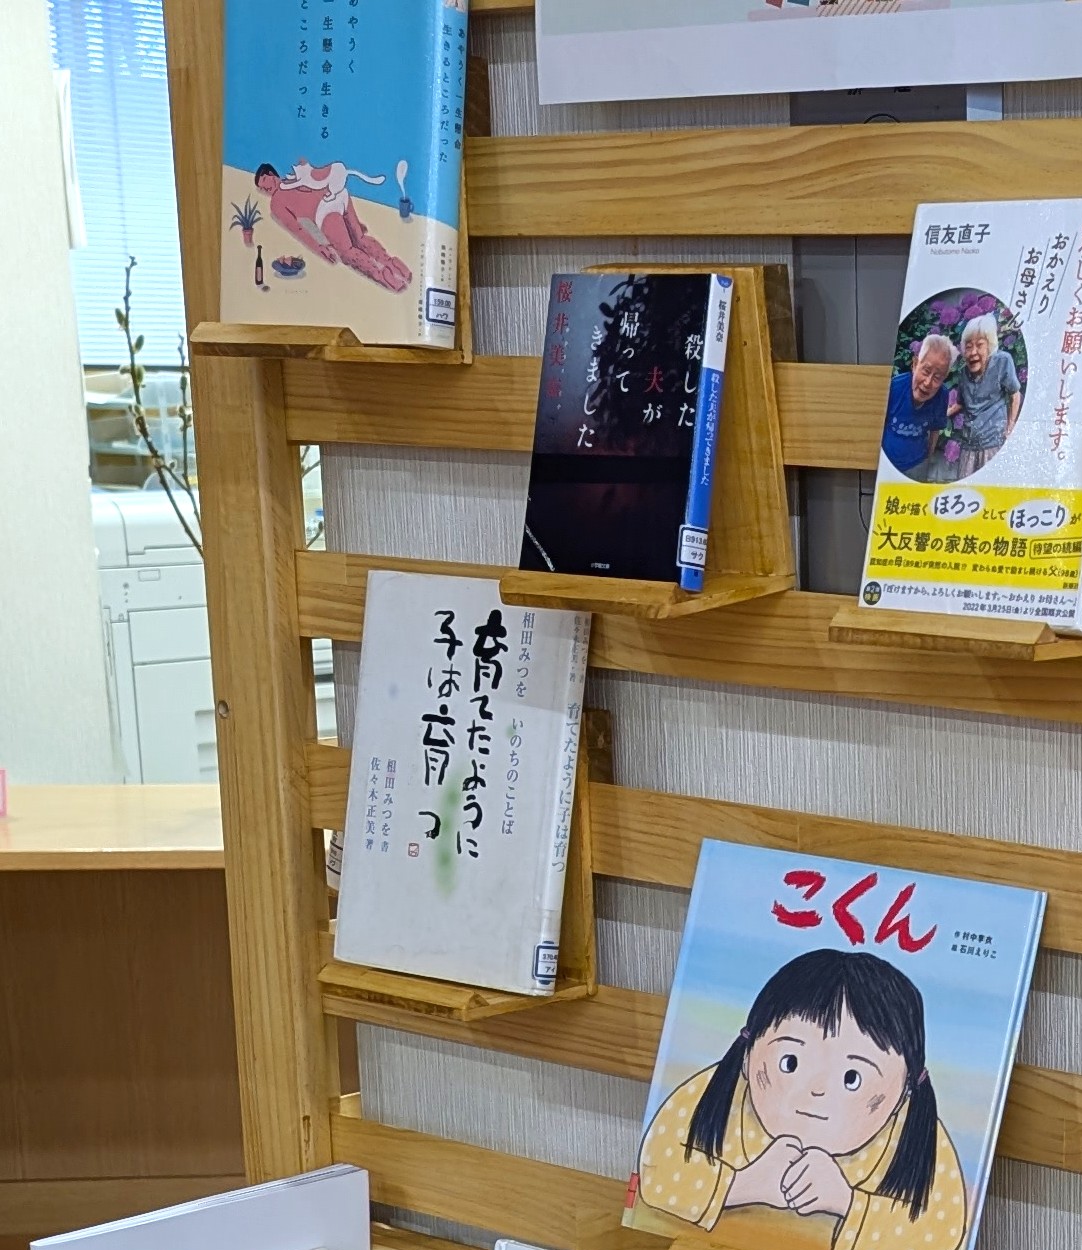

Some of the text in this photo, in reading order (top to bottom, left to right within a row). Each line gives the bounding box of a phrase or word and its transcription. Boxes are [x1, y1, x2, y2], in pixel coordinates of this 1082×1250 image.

[321, 0, 334, 139] 一生懸命生きる
[439, 24, 453, 163] 生きるところだった
[924, 222, 991, 245] 信友直子
[1037, 233, 1067, 314] おかえり
[716, 299, 728, 343] 桜井美奈
[1008, 246, 1042, 330] お母さん
[576, 325, 604, 448] きました
[616, 311, 640, 393] 帰って
[642, 366, 664, 423] 夫が
[677, 333, 704, 428] 殺した
[878, 526, 1028, 558] 大反響の家族の物語
[418, 610, 464, 840] 子は育つ
[456, 608, 509, 859] 育てたように
[500, 611, 536, 835] 相田みつを いのちのことば
[552, 703, 581, 873] 育てたように子は育つ
[771, 869, 938, 953] こくん
